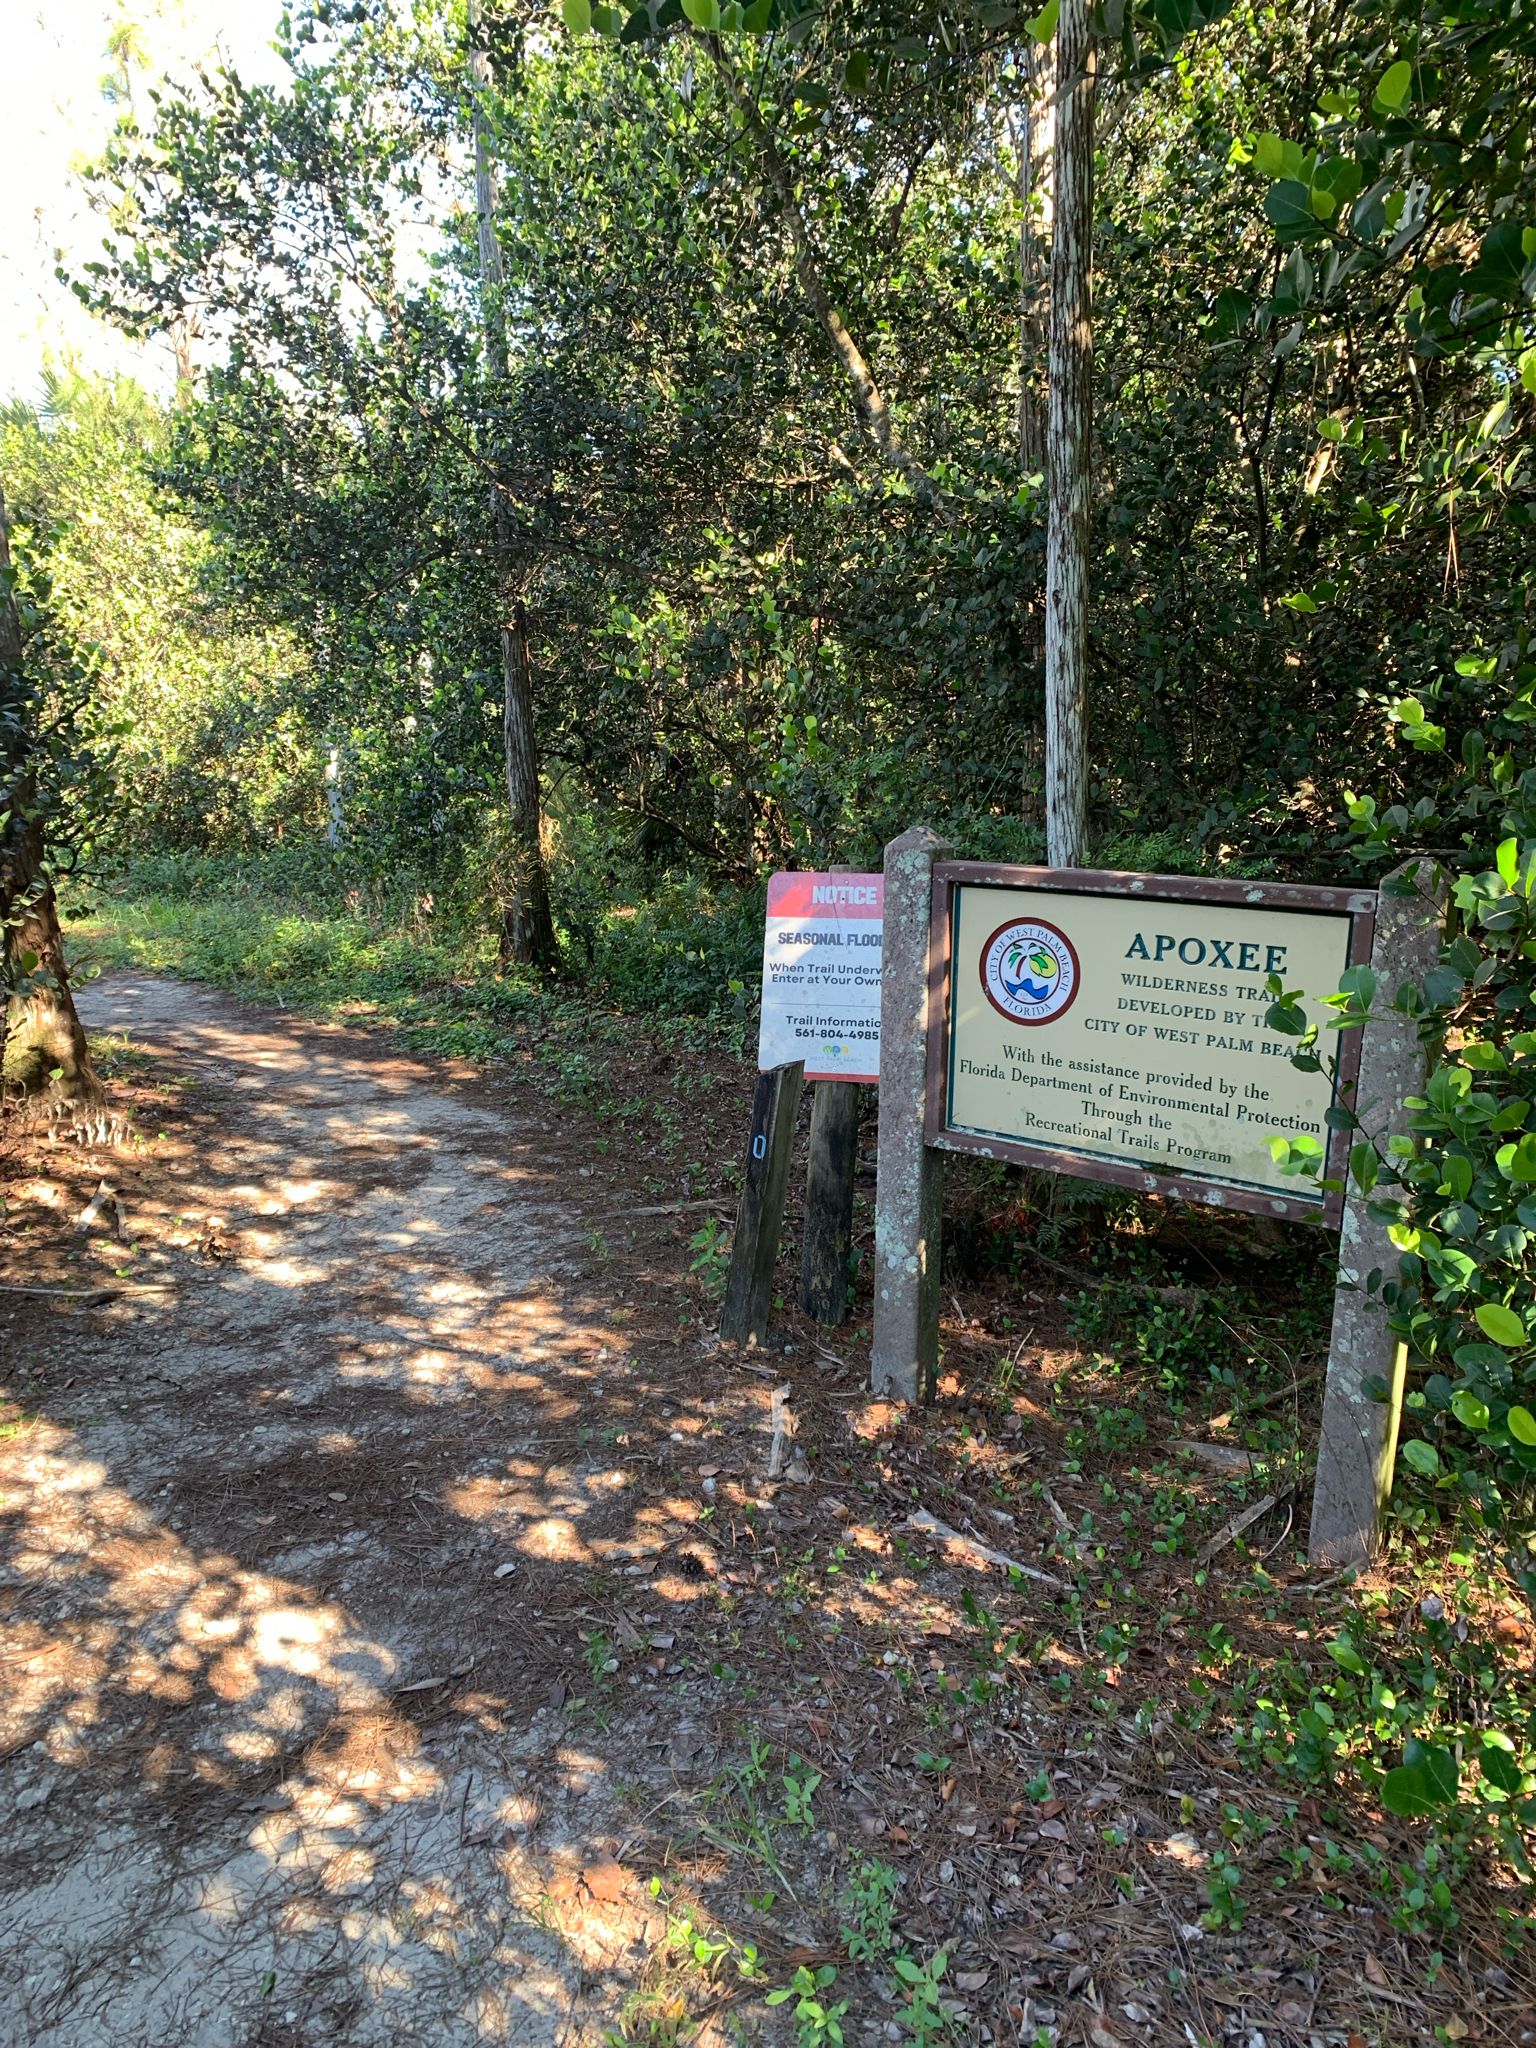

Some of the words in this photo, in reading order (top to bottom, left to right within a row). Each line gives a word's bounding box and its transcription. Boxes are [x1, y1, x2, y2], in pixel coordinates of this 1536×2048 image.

[813, 886, 877, 905] NOTICE
[778, 932, 844, 946] SEASONAL
[990, 956, 999, 981] CITY
[995, 942, 1006, 953] OF
[1006, 928, 1035, 940] WEST
[1037, 928, 1062, 953] PALM
[1059, 954, 1070, 992] BEACH
[1125, 933, 1287, 975] APOXEE
[769, 963, 804, 973] When
[808, 964, 834, 974] Trail
[772, 974, 804, 983] Enter
[807, 975, 820, 984] at
[823, 976, 851, 985] Your
[1121, 973, 1228, 997] WILDERNESS
[1236, 987, 1282, 1003] TRAI
[786, 1015, 813, 1025] Trail
[1003, 996, 1052, 1016] FLORIDA
[1117, 998, 1216, 1021] DEVELOPED
[1223, 1011, 1246, 1025] BY
[795, 1028, 879, 1040] 561-804-4985
[1084, 1018, 1120, 1033] CITY
[1126, 1024, 1147, 1036] OF
[1154, 1027, 1199, 1044] WEST
[1206, 1034, 1253, 1053] PALM
[1003, 1045, 1035, 1063] With
[1041, 1052, 1063, 1068] the
[1069, 1059, 1140, 1080] assistance
[1146, 1072, 1213, 1092] provided
[1219, 1078, 1238, 1098] by
[1245, 1083, 1270, 1101] the
[960, 1059, 1005, 1080] Florida
[1011, 1068, 1092, 1095] Department
[1099, 1084, 1114, 1098] of
[1119, 1085, 1229, 1117] Environmental
[1237, 1104, 1321, 1133] Protection
[1082, 1100, 1142, 1126] Through
[1149, 1113, 1172, 1130] the
[1025, 1112, 1112, 1141] Recreational
[1118, 1129, 1160, 1151] Trails
[1167, 1138, 1232, 1164] Program
